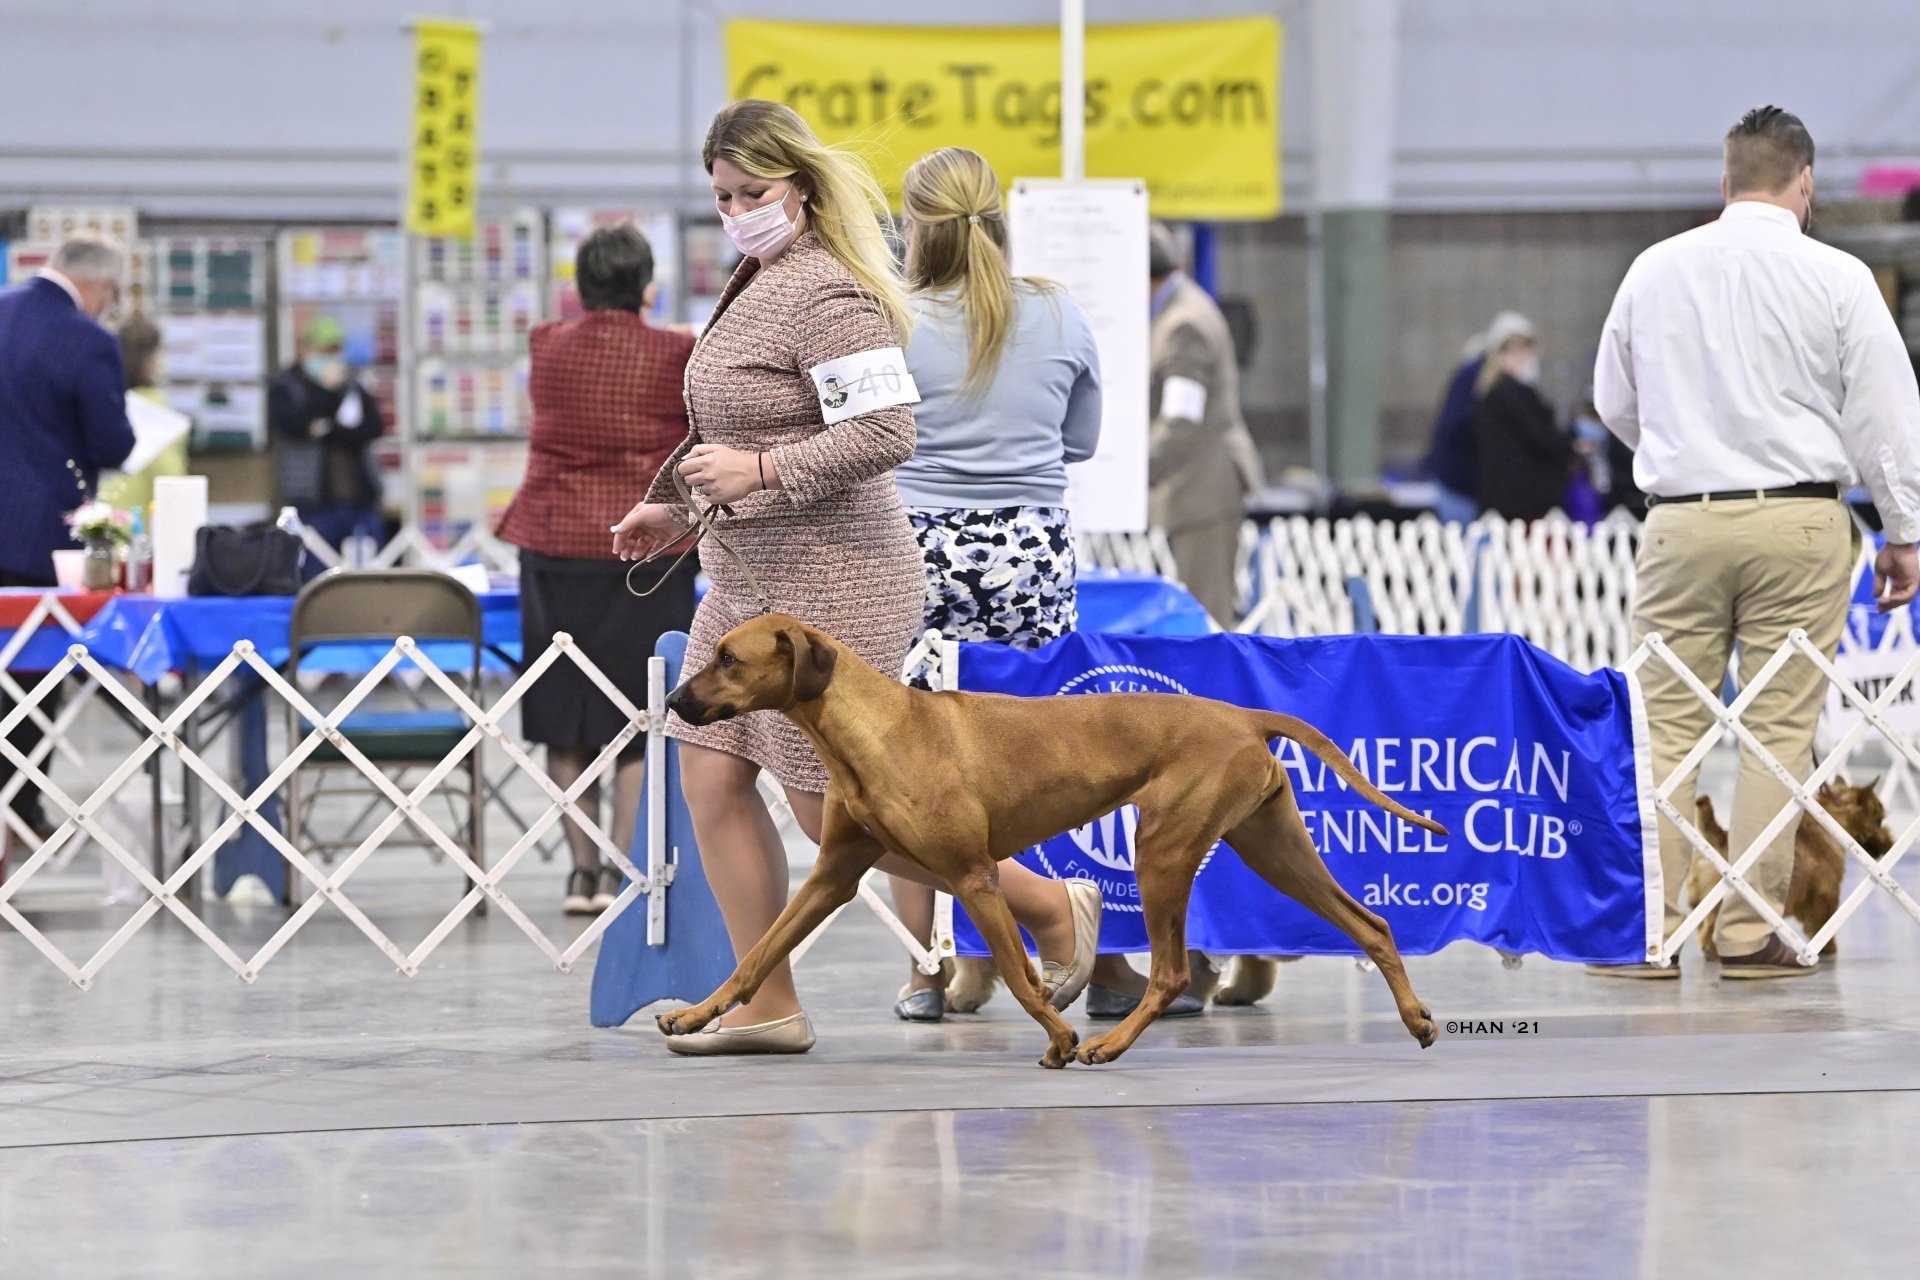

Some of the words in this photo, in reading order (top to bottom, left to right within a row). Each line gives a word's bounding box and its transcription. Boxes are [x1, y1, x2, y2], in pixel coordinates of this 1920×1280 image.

[858, 364, 902, 397] 40
[1302, 809, 1449, 855] ENNEL
[1064, 859, 1140, 899] FOUNDE
[1363, 873, 1490, 911] akc.org
